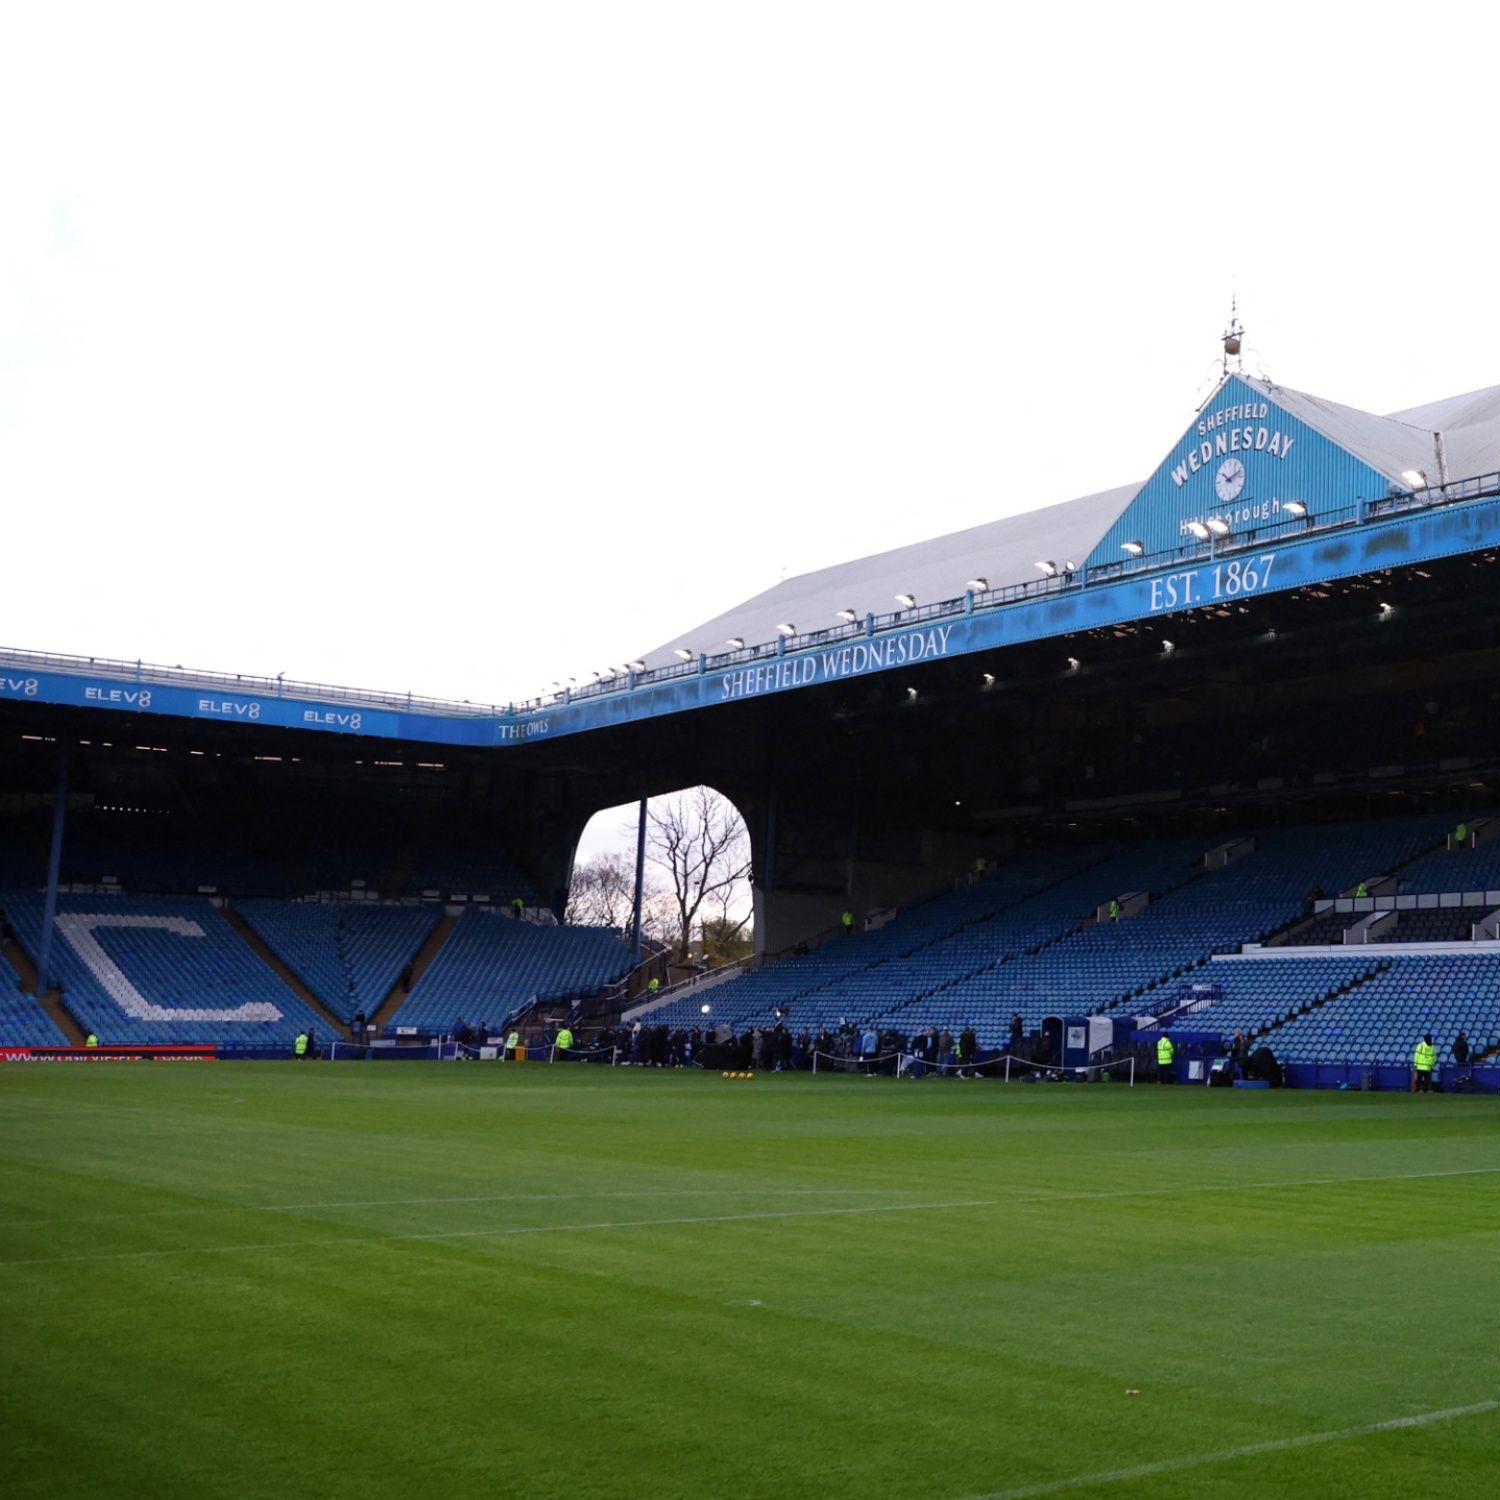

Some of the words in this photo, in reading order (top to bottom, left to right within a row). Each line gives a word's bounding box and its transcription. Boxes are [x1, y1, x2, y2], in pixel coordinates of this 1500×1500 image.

[1199, 403, 1268, 436] SHEFFIELD
[1171, 427, 1294, 487] WEDNESDAY
[1149, 573, 1201, 611] EST.
[1211, 554, 1276, 599] 1867
[721, 655, 817, 699] SHEFFIELD
[822, 625, 953, 679] WEDNESDAY
[85, 687, 152, 708] ELEV8
[198, 699, 261, 720] ELEV8
[303, 710, 362, 730] ELEV8
[498, 724, 527, 739] THE
[526, 717, 549, 736] OWLS
